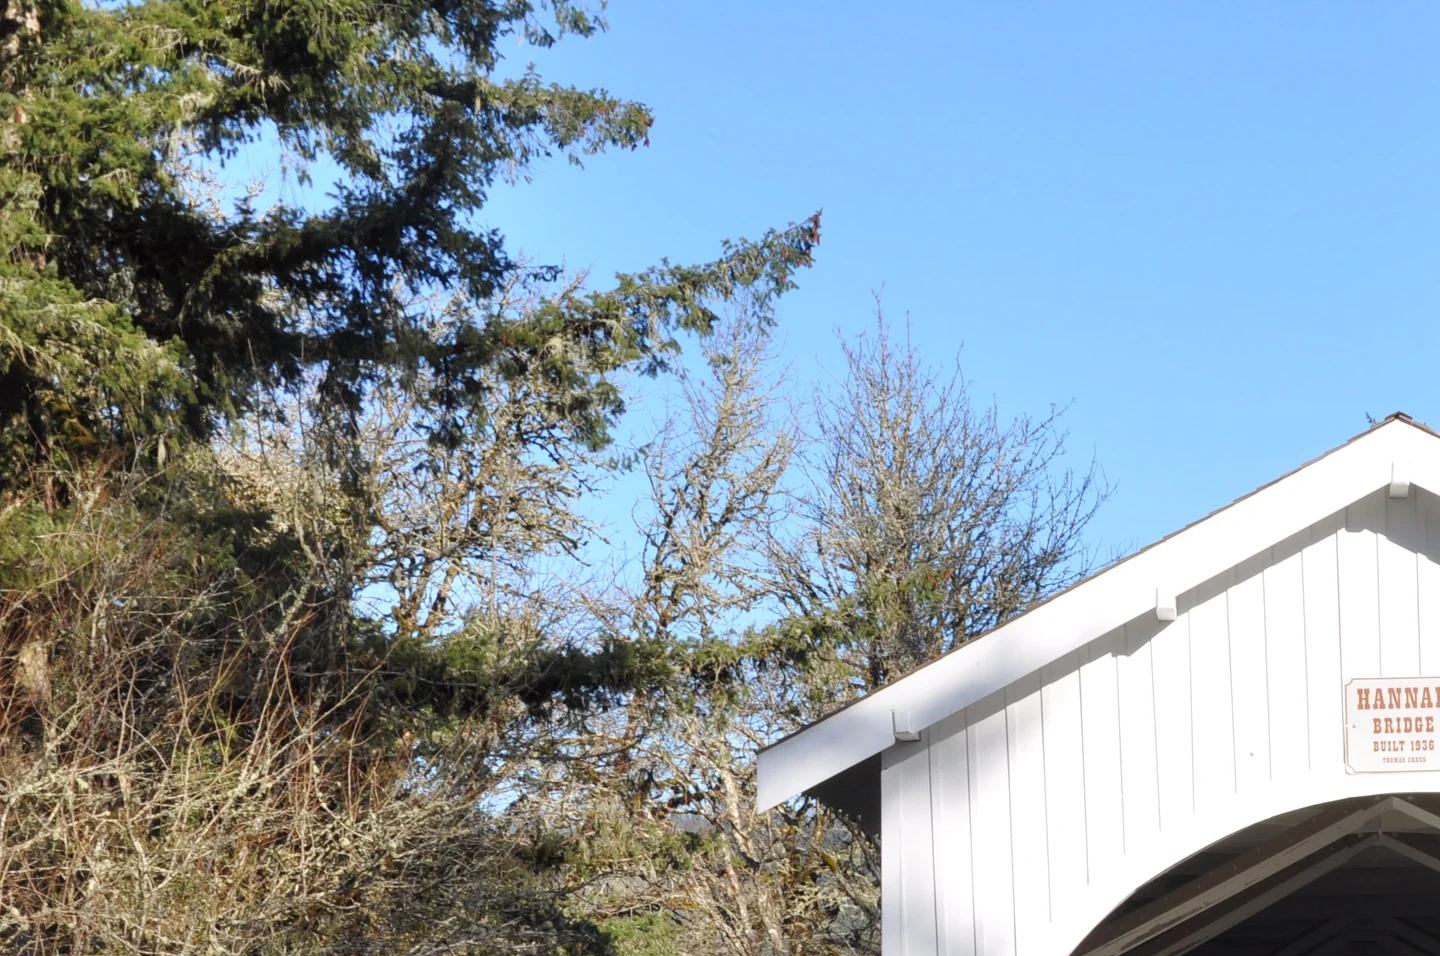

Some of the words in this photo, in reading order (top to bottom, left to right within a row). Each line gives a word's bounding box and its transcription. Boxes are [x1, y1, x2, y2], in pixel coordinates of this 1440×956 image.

[1373, 716, 1434, 734] BRIDGE
[1373, 741, 1405, 752] BUILT
[1410, 740, 1435, 751] 1936
